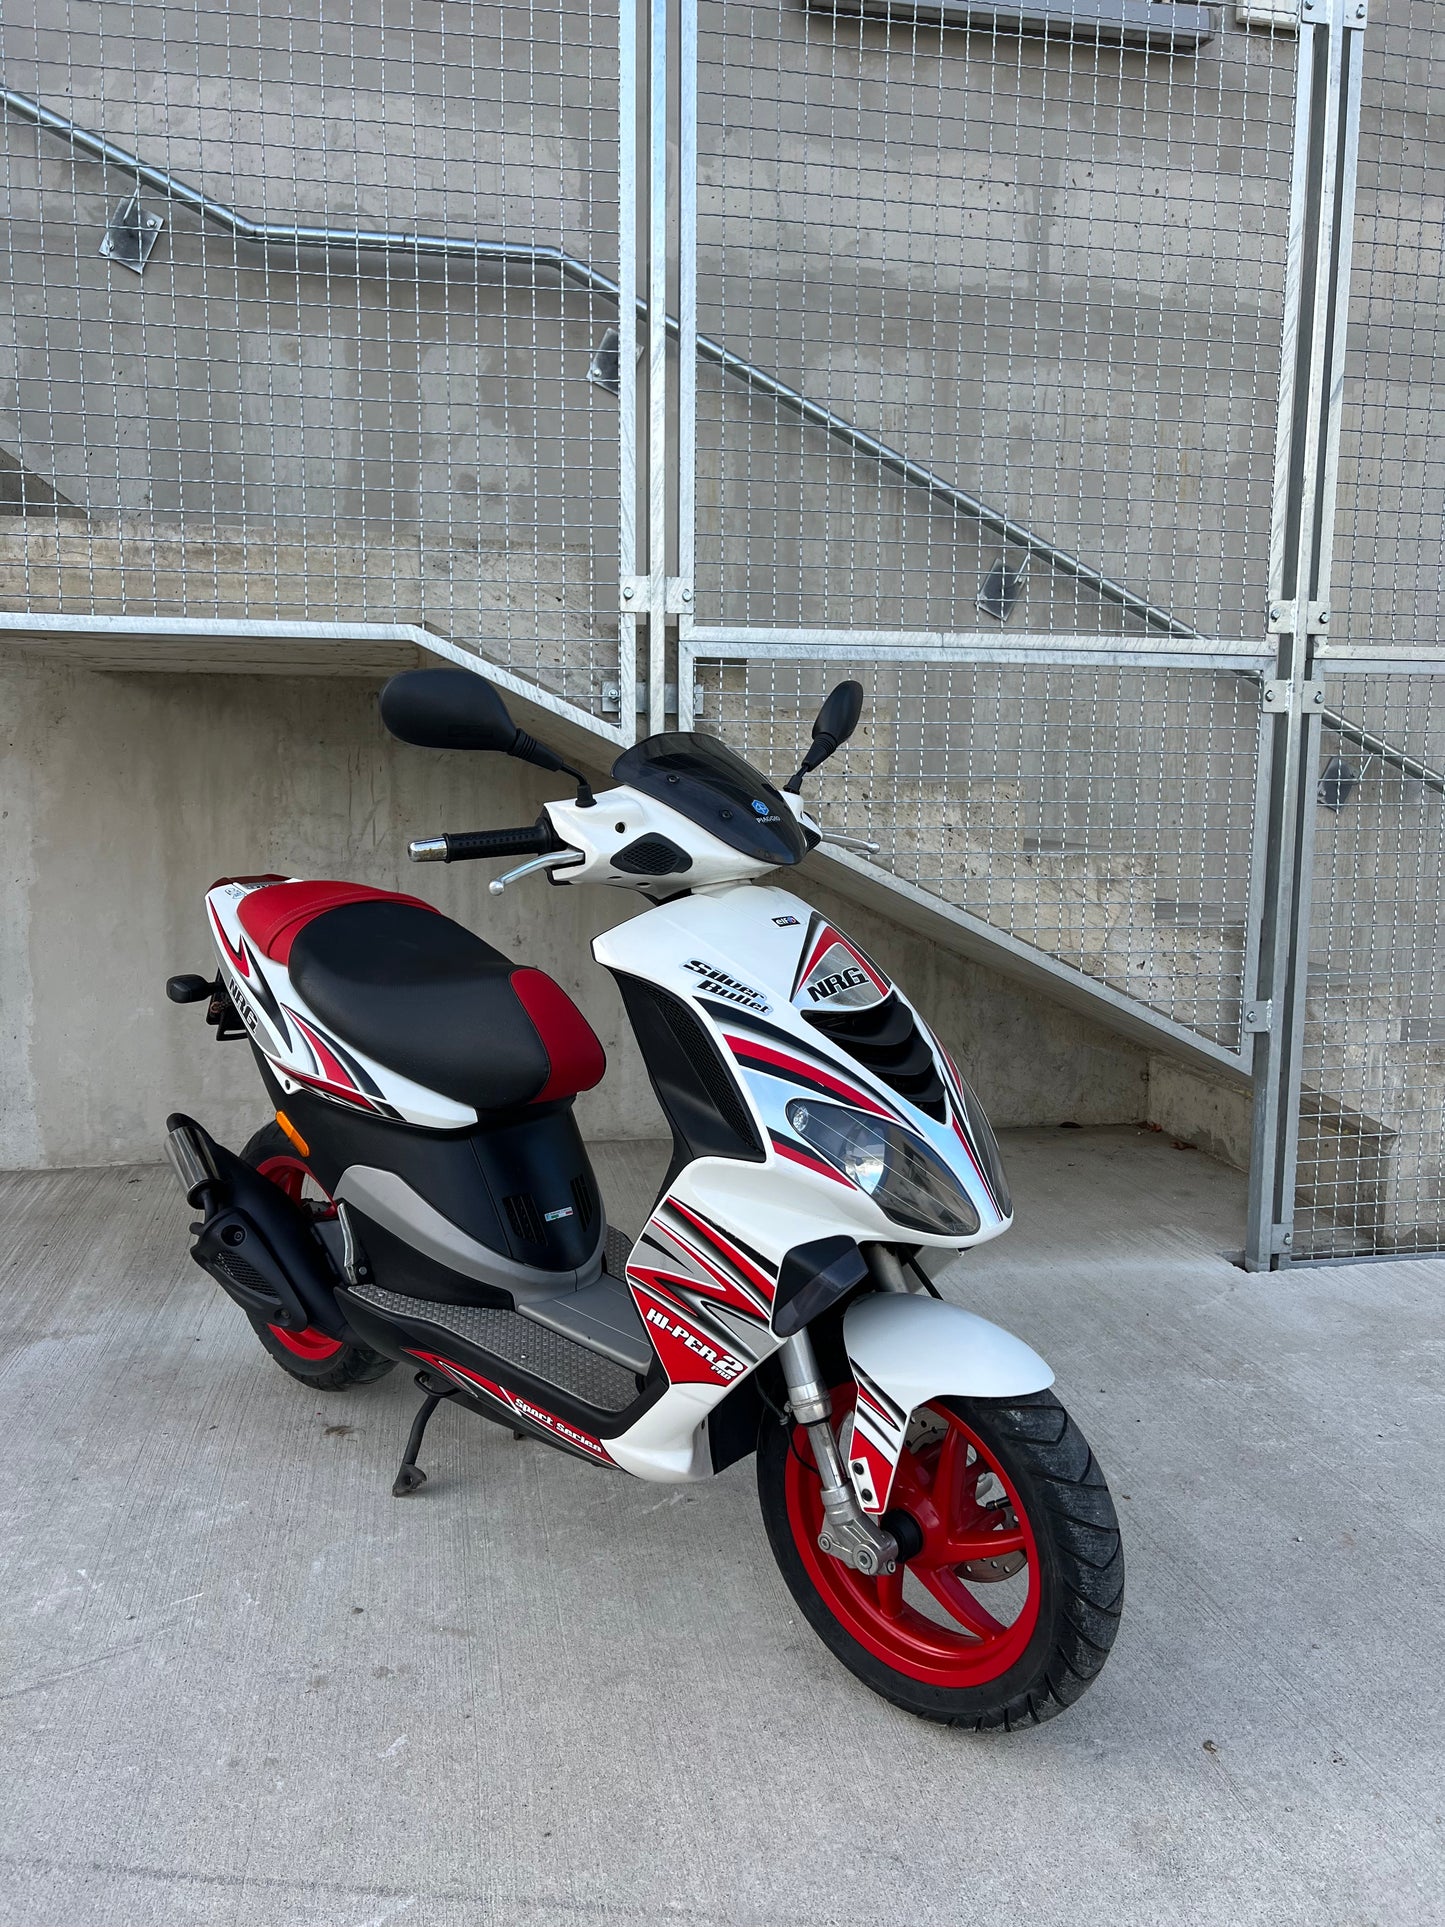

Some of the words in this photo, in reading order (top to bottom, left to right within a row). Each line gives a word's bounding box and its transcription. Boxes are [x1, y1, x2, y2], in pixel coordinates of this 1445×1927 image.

[756, 815, 781, 823] PIAGGIO
[683, 960, 764, 998] Silver
[696, 979, 770, 1014] Bullet
[807, 966, 869, 1002] NRG
[229, 977, 258, 1035] NRG
[710, 1364, 732, 1380] PRO
[515, 1398, 554, 1427] Sport
